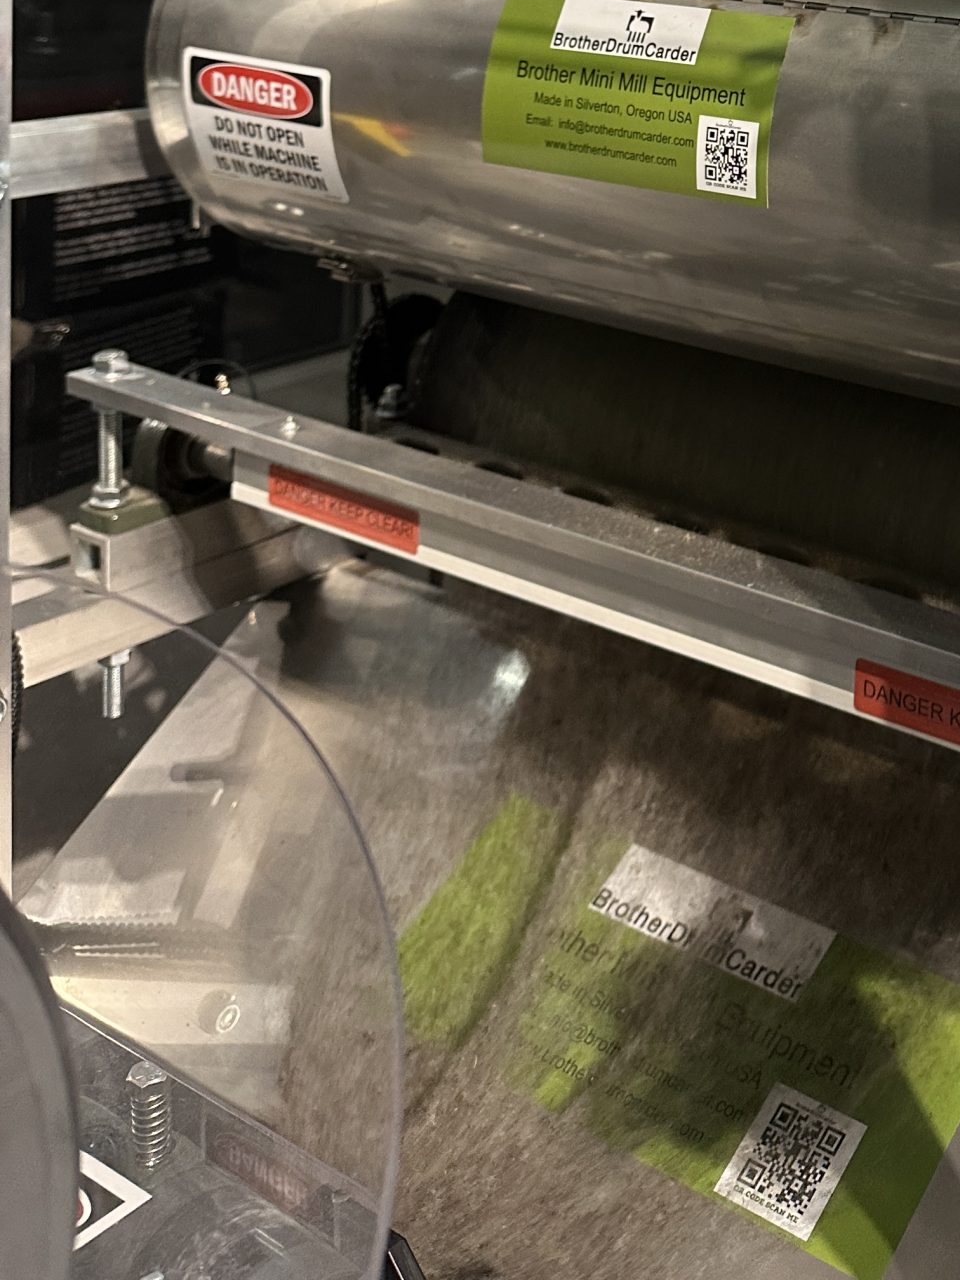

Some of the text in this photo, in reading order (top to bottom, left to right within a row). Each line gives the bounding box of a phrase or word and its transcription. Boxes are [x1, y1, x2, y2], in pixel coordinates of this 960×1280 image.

[553, 32, 696, 62] BrotherDrumCarder
[211, 71, 298, 111] DANGER
[516, 59, 746, 107] Brother Mini Mill Equipment
[533, 91, 693, 124] Made in Silverton, Oregon USA
[214, 116, 305, 148] DO NOT OPEN
[525, 113, 694, 148] Email: info@brotherdrumcarder.com
[208, 135, 322, 172] WHILE MACHINE
[544, 139, 677, 168] www.brotherdrumcarder.com
[215, 155, 231, 171] IS
[232, 160, 249, 175] IN
[249, 162, 328, 191] OPERATION
[863, 679, 944, 721] DANGER
[745, 1190, 765, 1207] CODE
[765, 1201, 787, 1216] SCAN
[786, 1212, 800, 1224] ME
